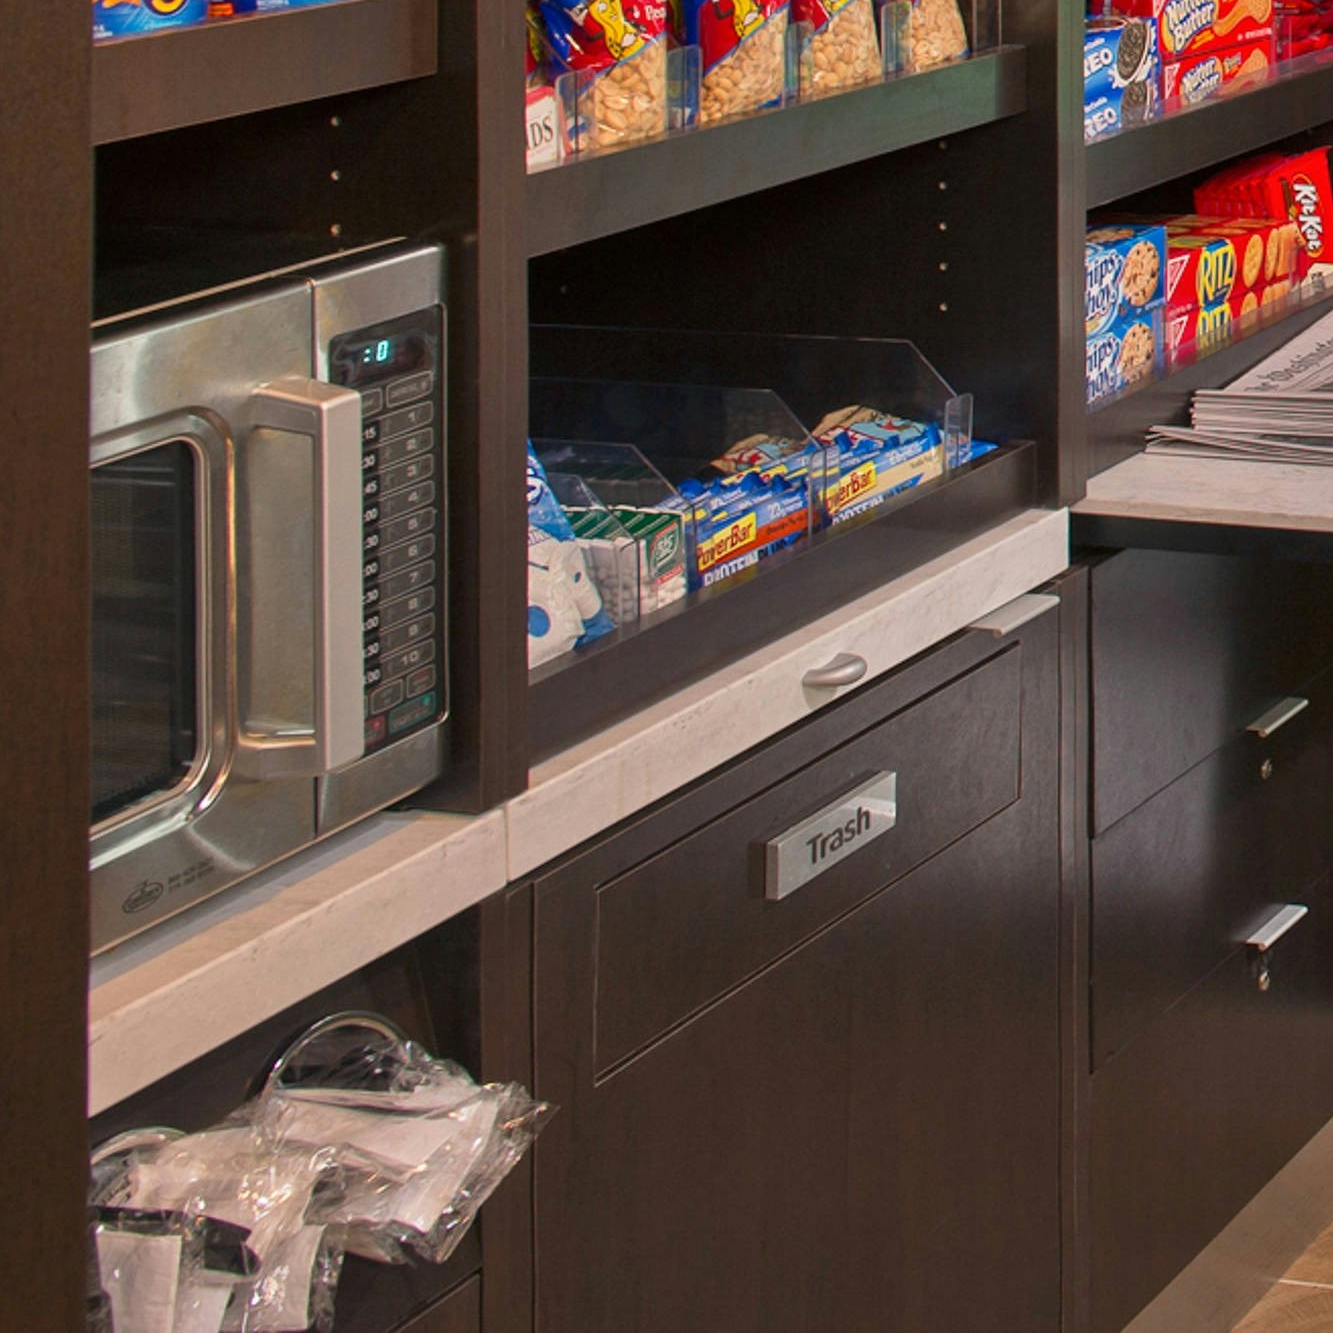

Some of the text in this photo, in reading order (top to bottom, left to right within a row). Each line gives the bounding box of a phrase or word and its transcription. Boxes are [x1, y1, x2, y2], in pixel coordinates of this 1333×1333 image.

[1173, 1, 1215, 54] Butter
[1200, 243, 1233, 302] RITZ
[806, 806, 871, 865] Trash
